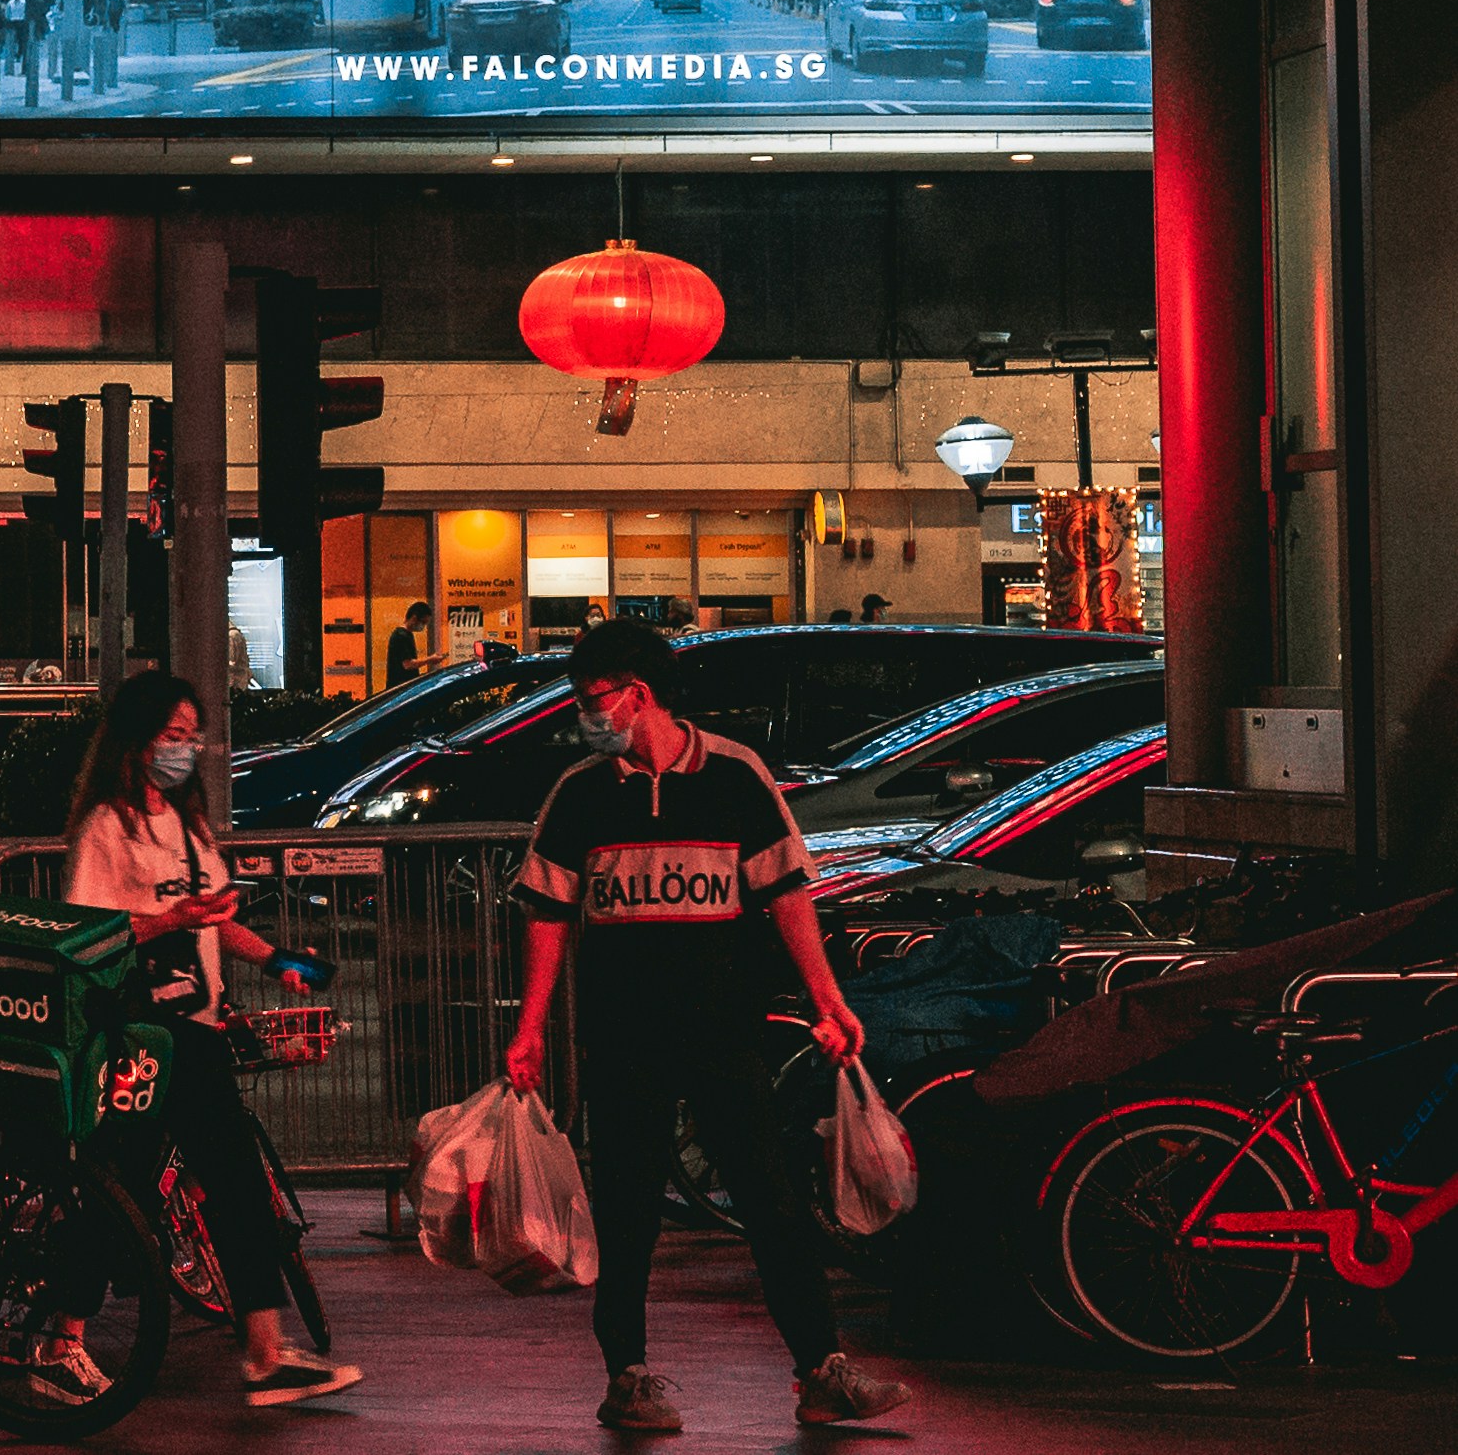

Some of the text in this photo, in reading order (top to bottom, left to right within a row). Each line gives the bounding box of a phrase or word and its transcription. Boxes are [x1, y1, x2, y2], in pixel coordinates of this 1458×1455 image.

[338, 53, 827, 84] WWW.FALCONMEDIA.SG
[989, 549, 1013, 558] 01-23
[447, 578, 516, 588] Withdraw Cash
[450, 606, 482, 627] atm
